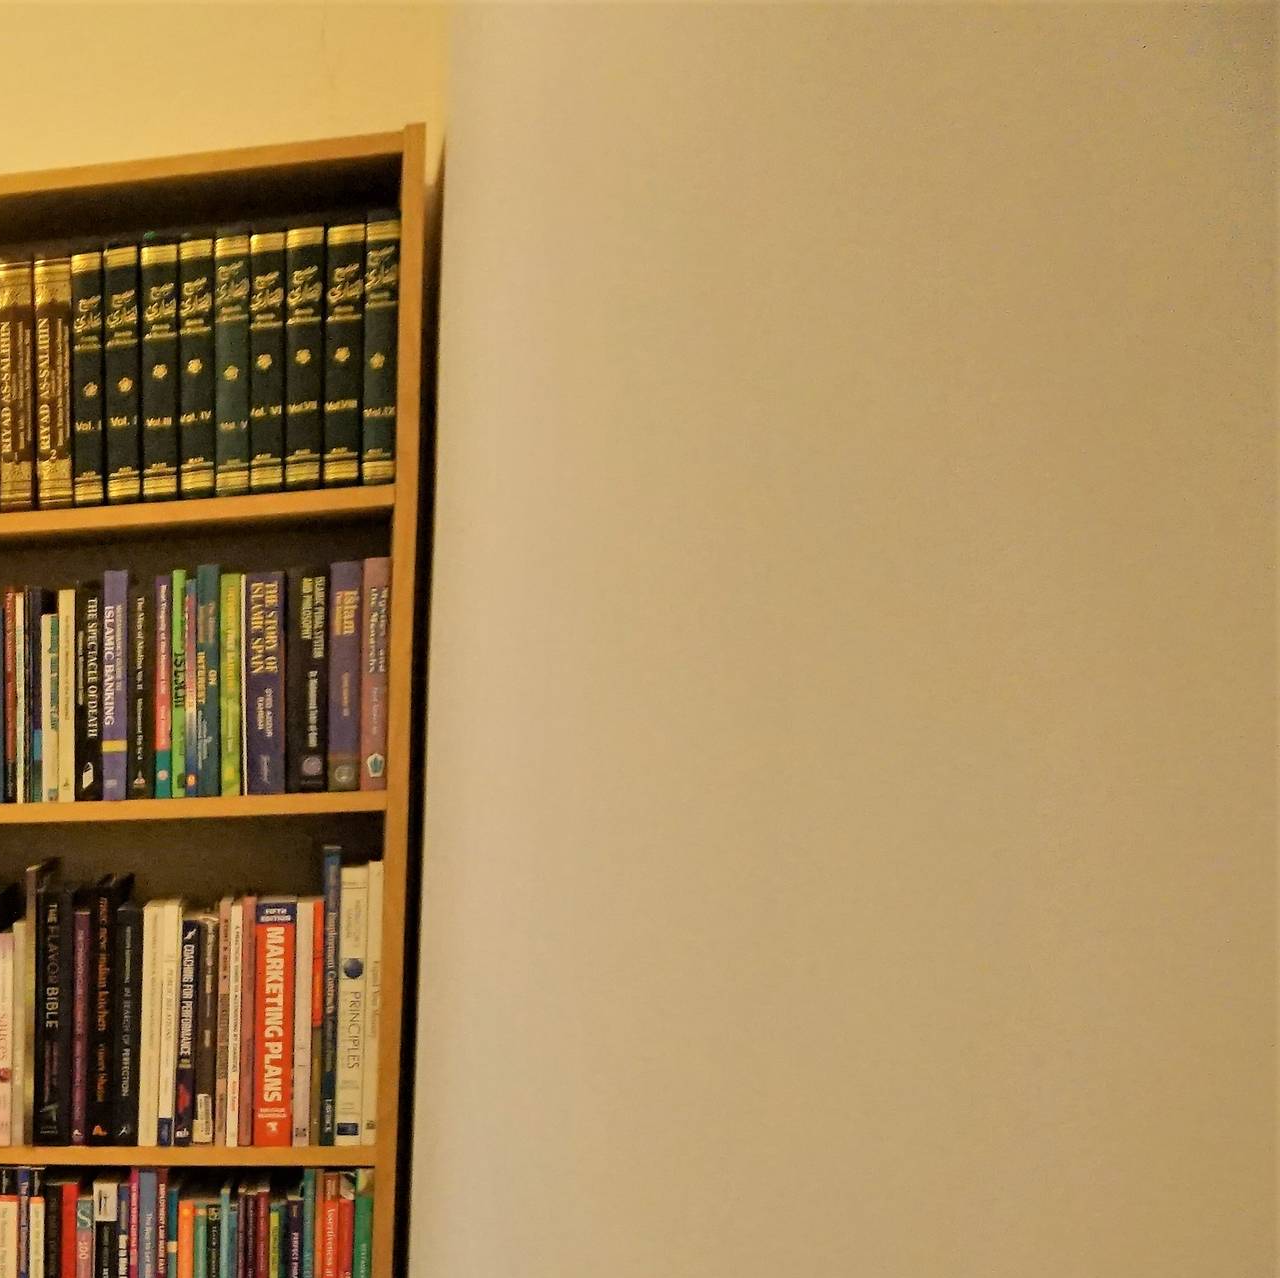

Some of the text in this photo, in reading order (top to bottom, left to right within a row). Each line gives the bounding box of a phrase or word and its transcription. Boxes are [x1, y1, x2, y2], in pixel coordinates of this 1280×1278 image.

[1, 407, 11, 453] RIYAD
[39, 404, 51, 450] RIYAD
[87, 598, 97, 619] THE
[251, 581, 265, 674] ISLAMIC SPAIN
[265, 581, 279, 673] THE STORY OF
[87, 622, 97, 684] SPECTACLE
[104, 606, 114, 726] ISLAMIC BANKING
[87, 701, 97, 738] DEATH
[47, 904, 58, 924] THE
[45, 986, 59, 1029] BIBLE
[180, 944, 195, 1056] COACHING FOR PERFORMANCE
[264, 927, 285, 1102] MARKETING PLANS
[346, 990, 361, 1069] PRINCIPLES
[121, 1048, 130, 1097] PERFECTION
[79, 1240, 88, 1259] 100
